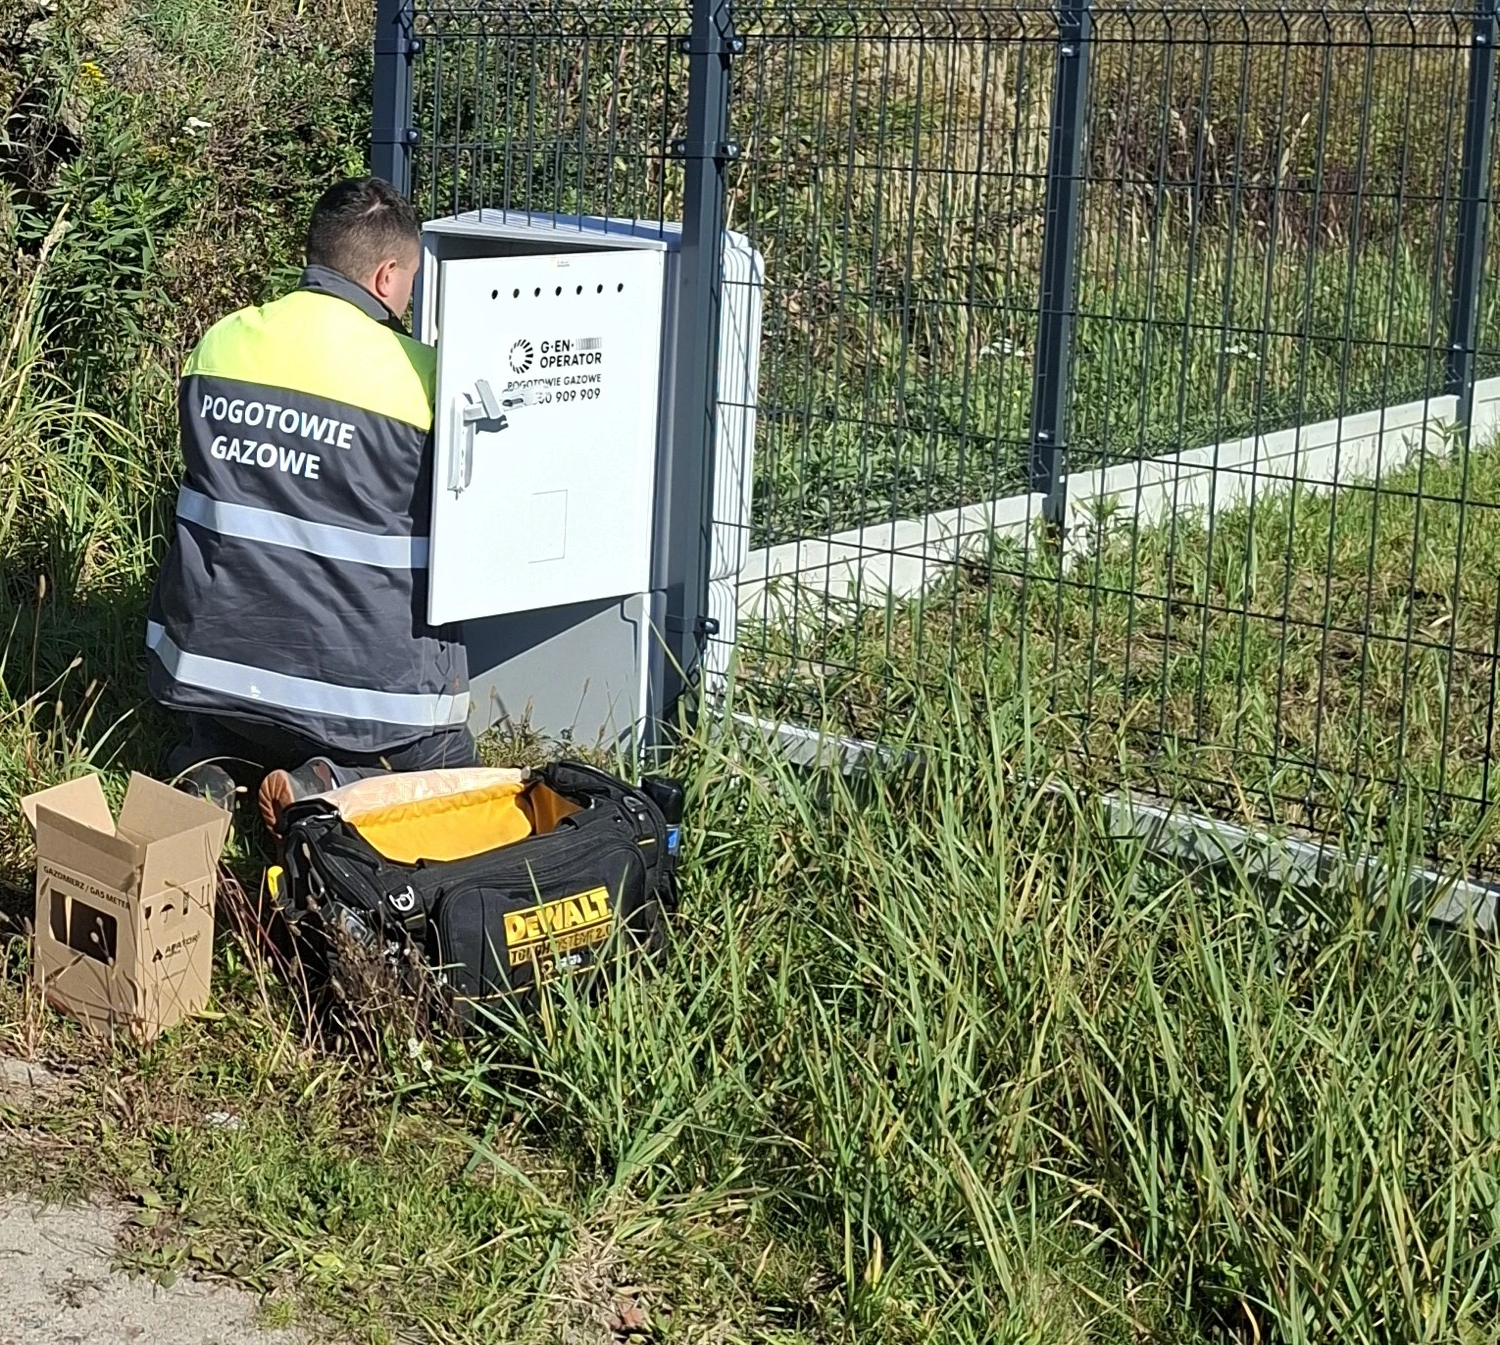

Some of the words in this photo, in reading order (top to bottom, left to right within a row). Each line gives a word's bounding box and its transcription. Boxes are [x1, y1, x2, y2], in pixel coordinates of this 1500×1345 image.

[539, 352, 602, 369] OPERATOR
[563, 373, 602, 386] GAZOWE
[556, 390, 577, 403] 909
[580, 387, 601, 401] 909
[200, 394, 356, 450] POGOTOWIE
[210, 434, 321, 480] GAZOWE
[43, 865, 85, 891] GAZOMIERZ
[90, 886, 105, 899] GAS
